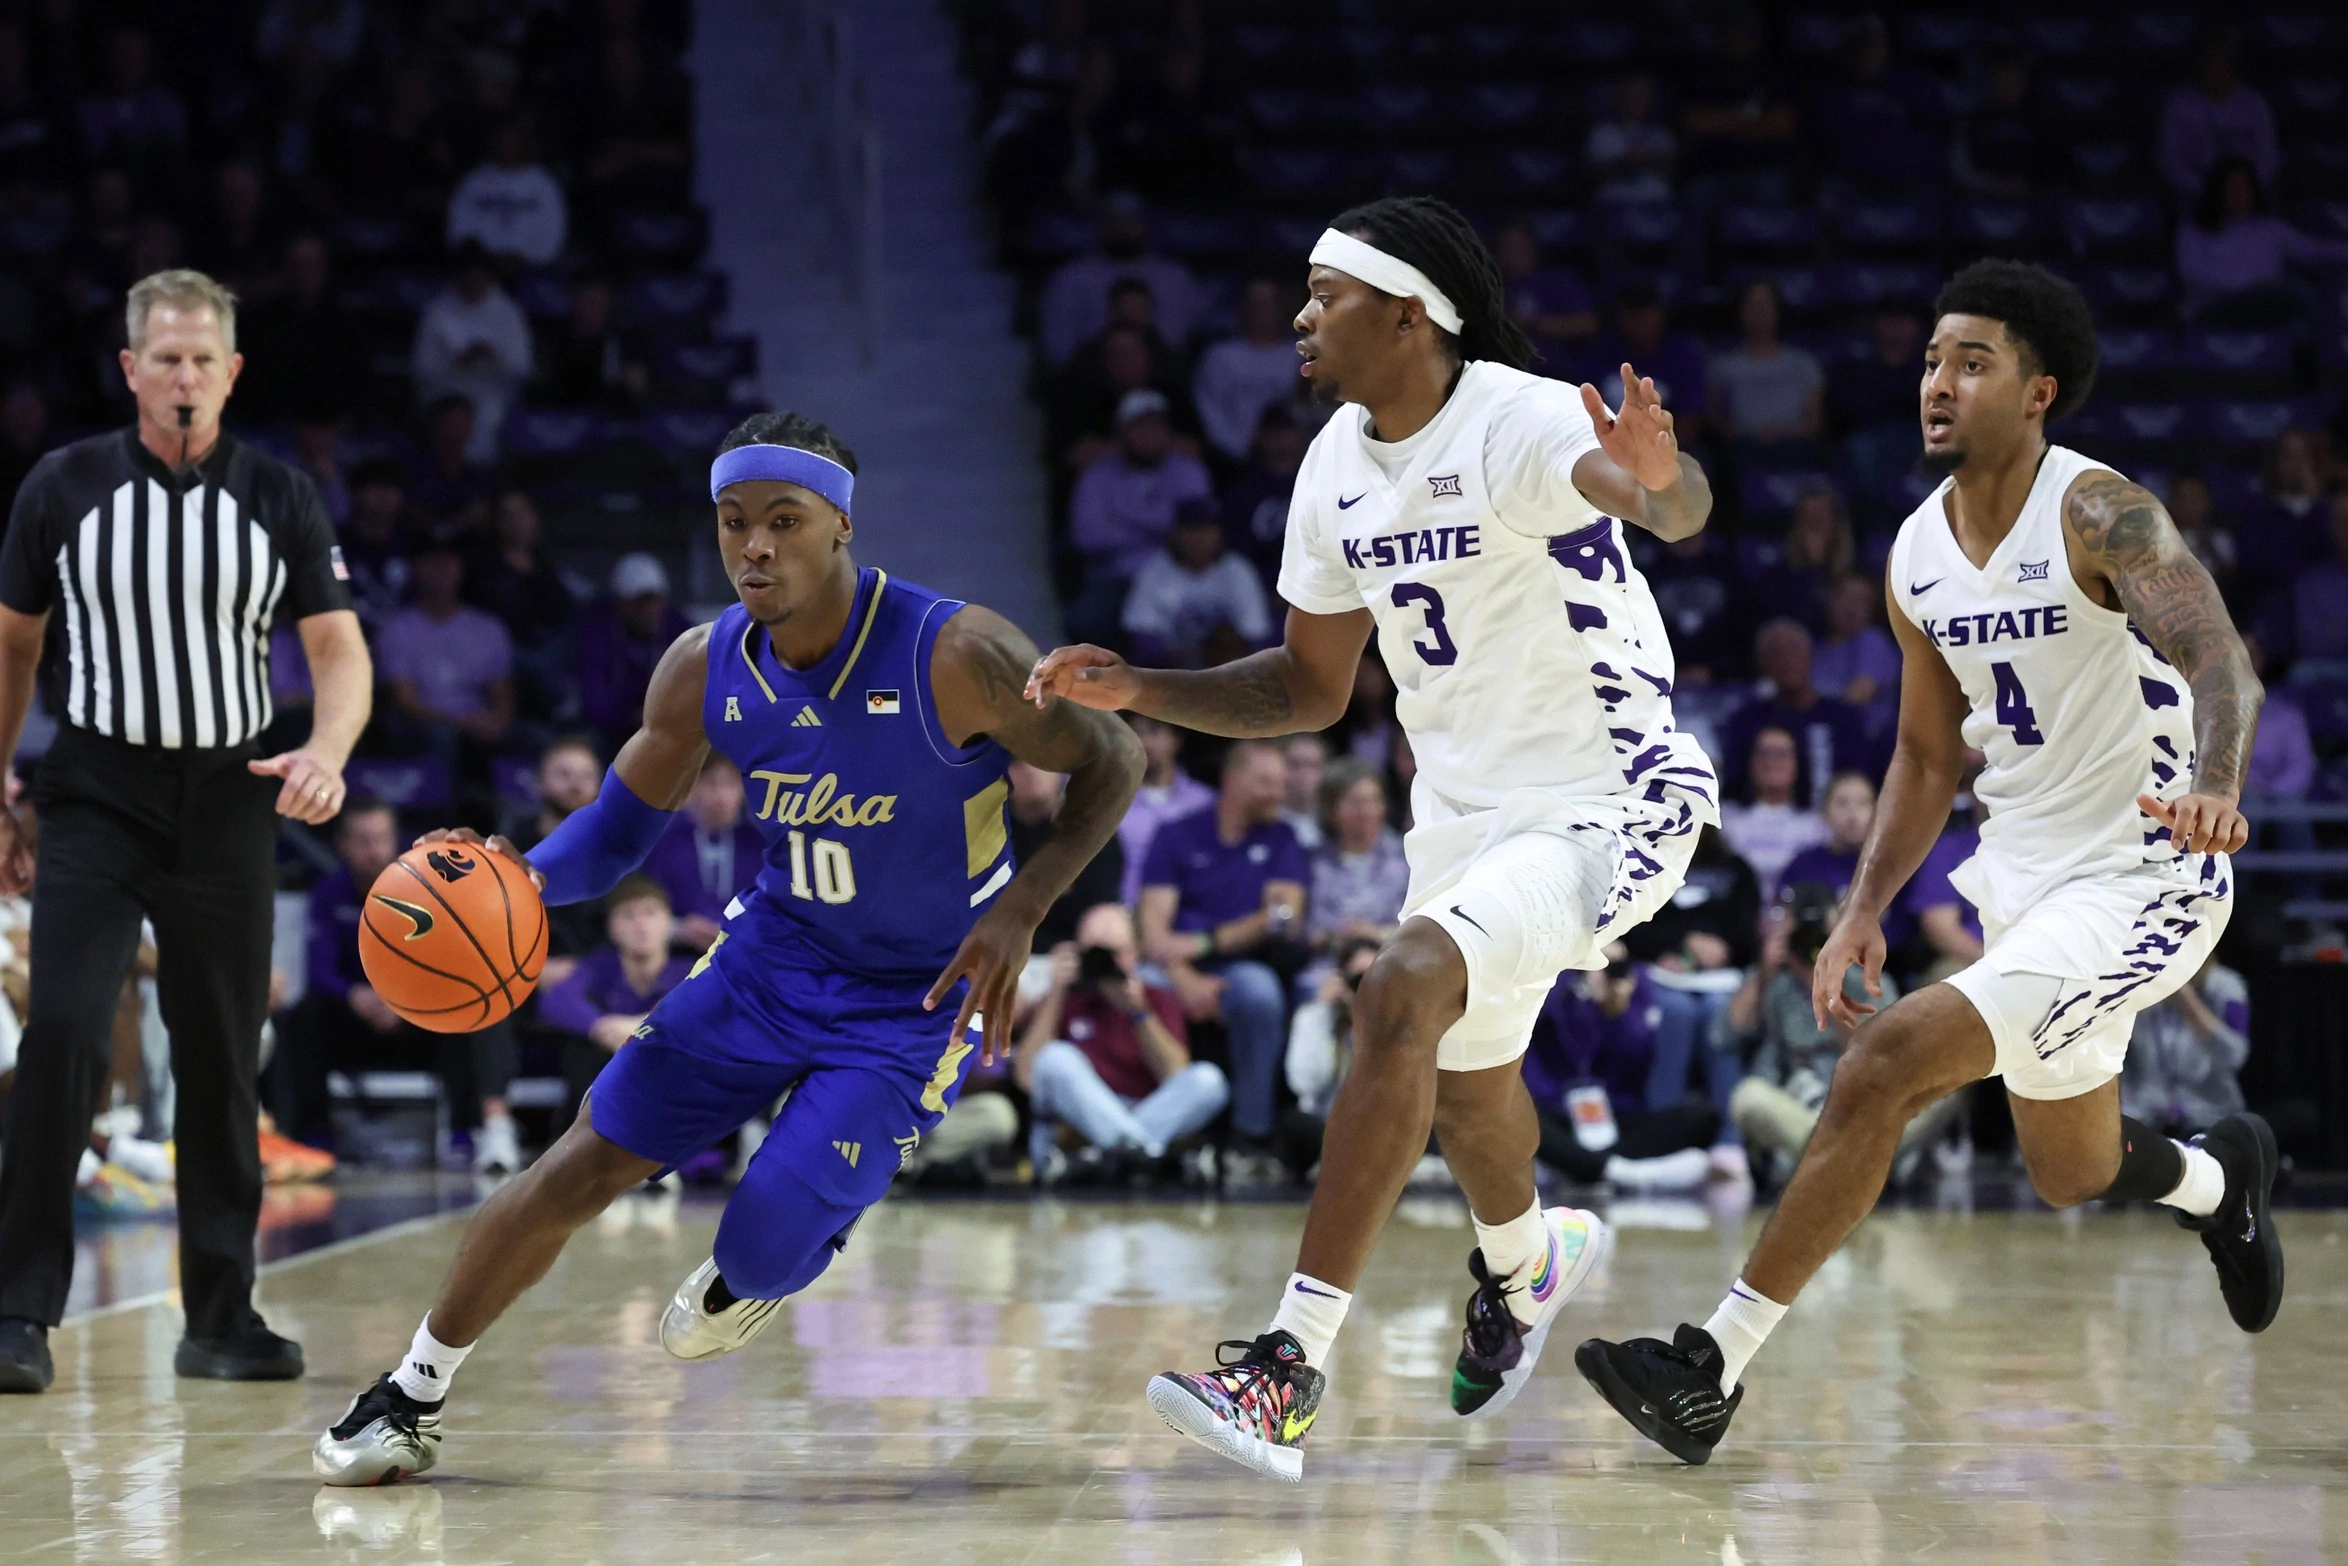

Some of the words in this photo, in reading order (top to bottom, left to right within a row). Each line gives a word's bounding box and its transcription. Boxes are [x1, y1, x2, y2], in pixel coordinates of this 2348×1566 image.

[1342, 525, 1481, 569] K-STATE
[1391, 582, 1458, 666] 3
[1922, 605, 2068, 647] K-STATE
[724, 697, 742, 721] A
[1991, 661, 2044, 745] 4
[750, 770, 898, 826] Tulsa
[788, 830, 857, 905] 10
